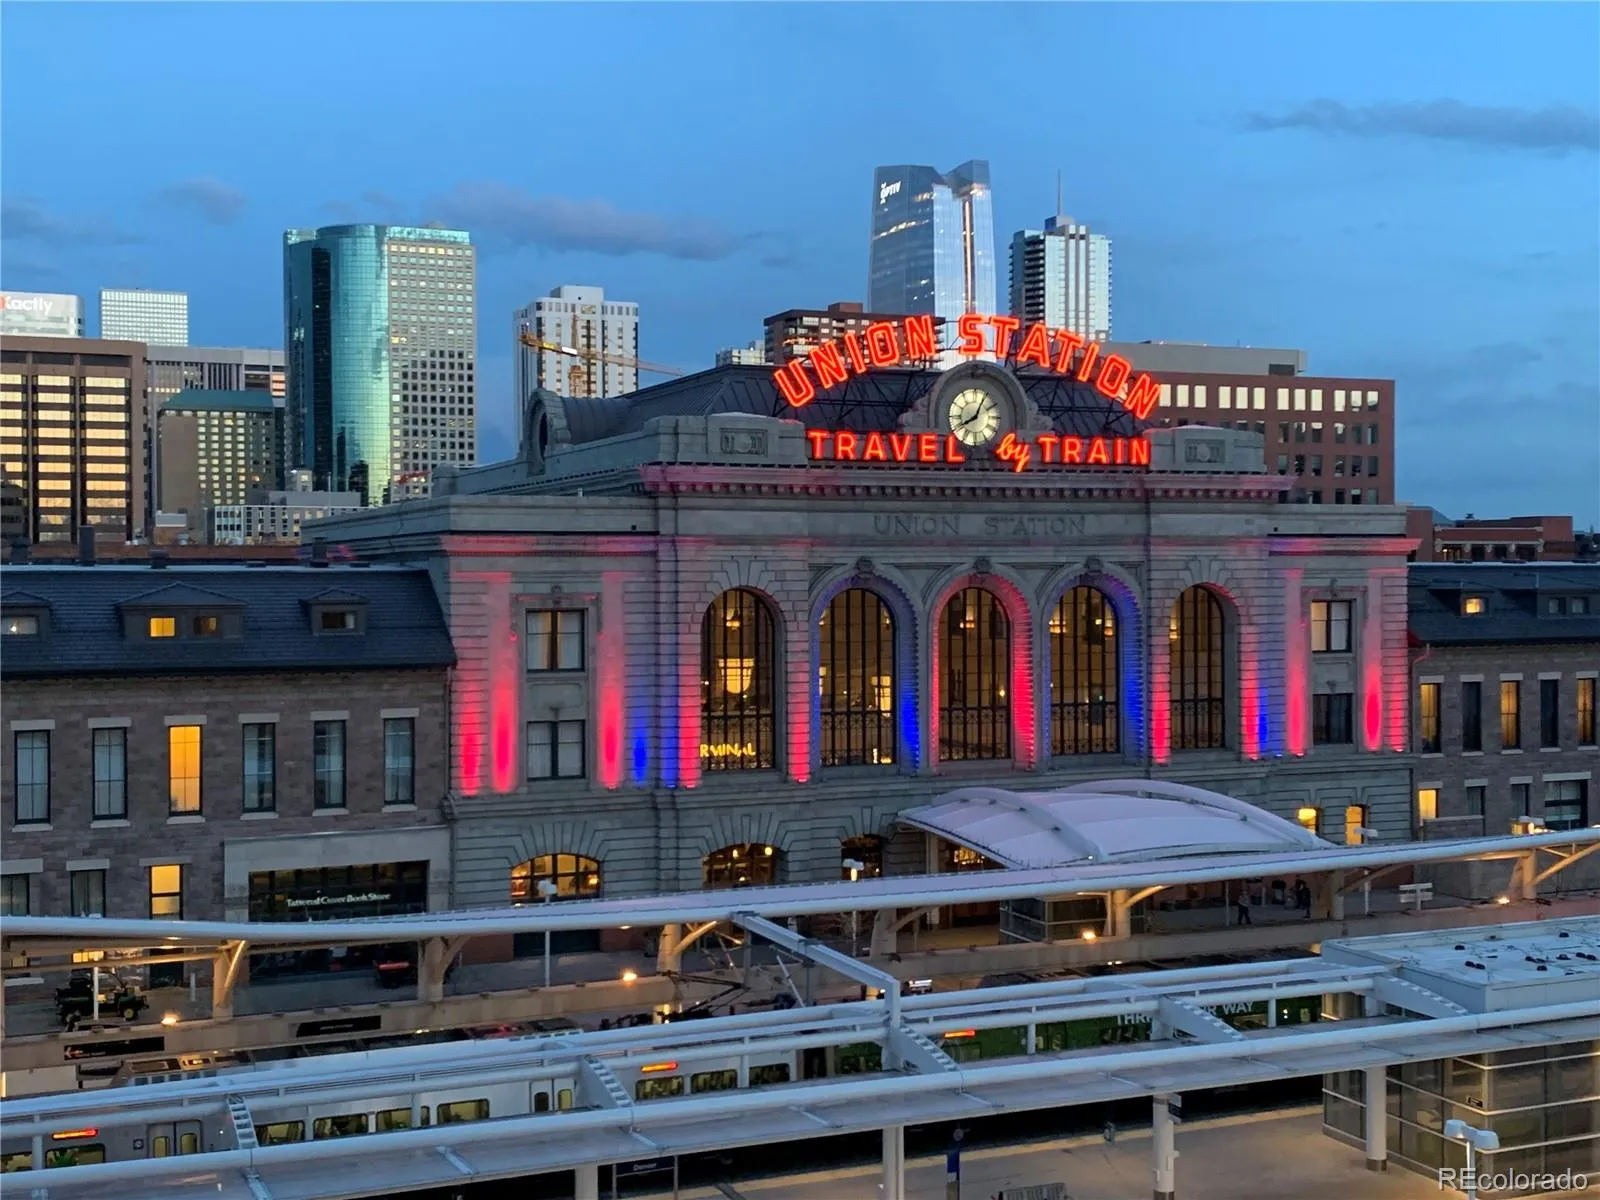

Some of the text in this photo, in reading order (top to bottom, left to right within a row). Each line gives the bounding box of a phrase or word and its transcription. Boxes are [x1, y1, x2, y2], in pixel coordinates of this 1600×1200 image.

[773, 313, 1161, 420] UNION STATION
[807, 429, 1151, 473] TRAVEL by TRAIN
[873, 514, 1086, 536] UNION STATION
[1223, 1000, 1254, 1015] WAY
